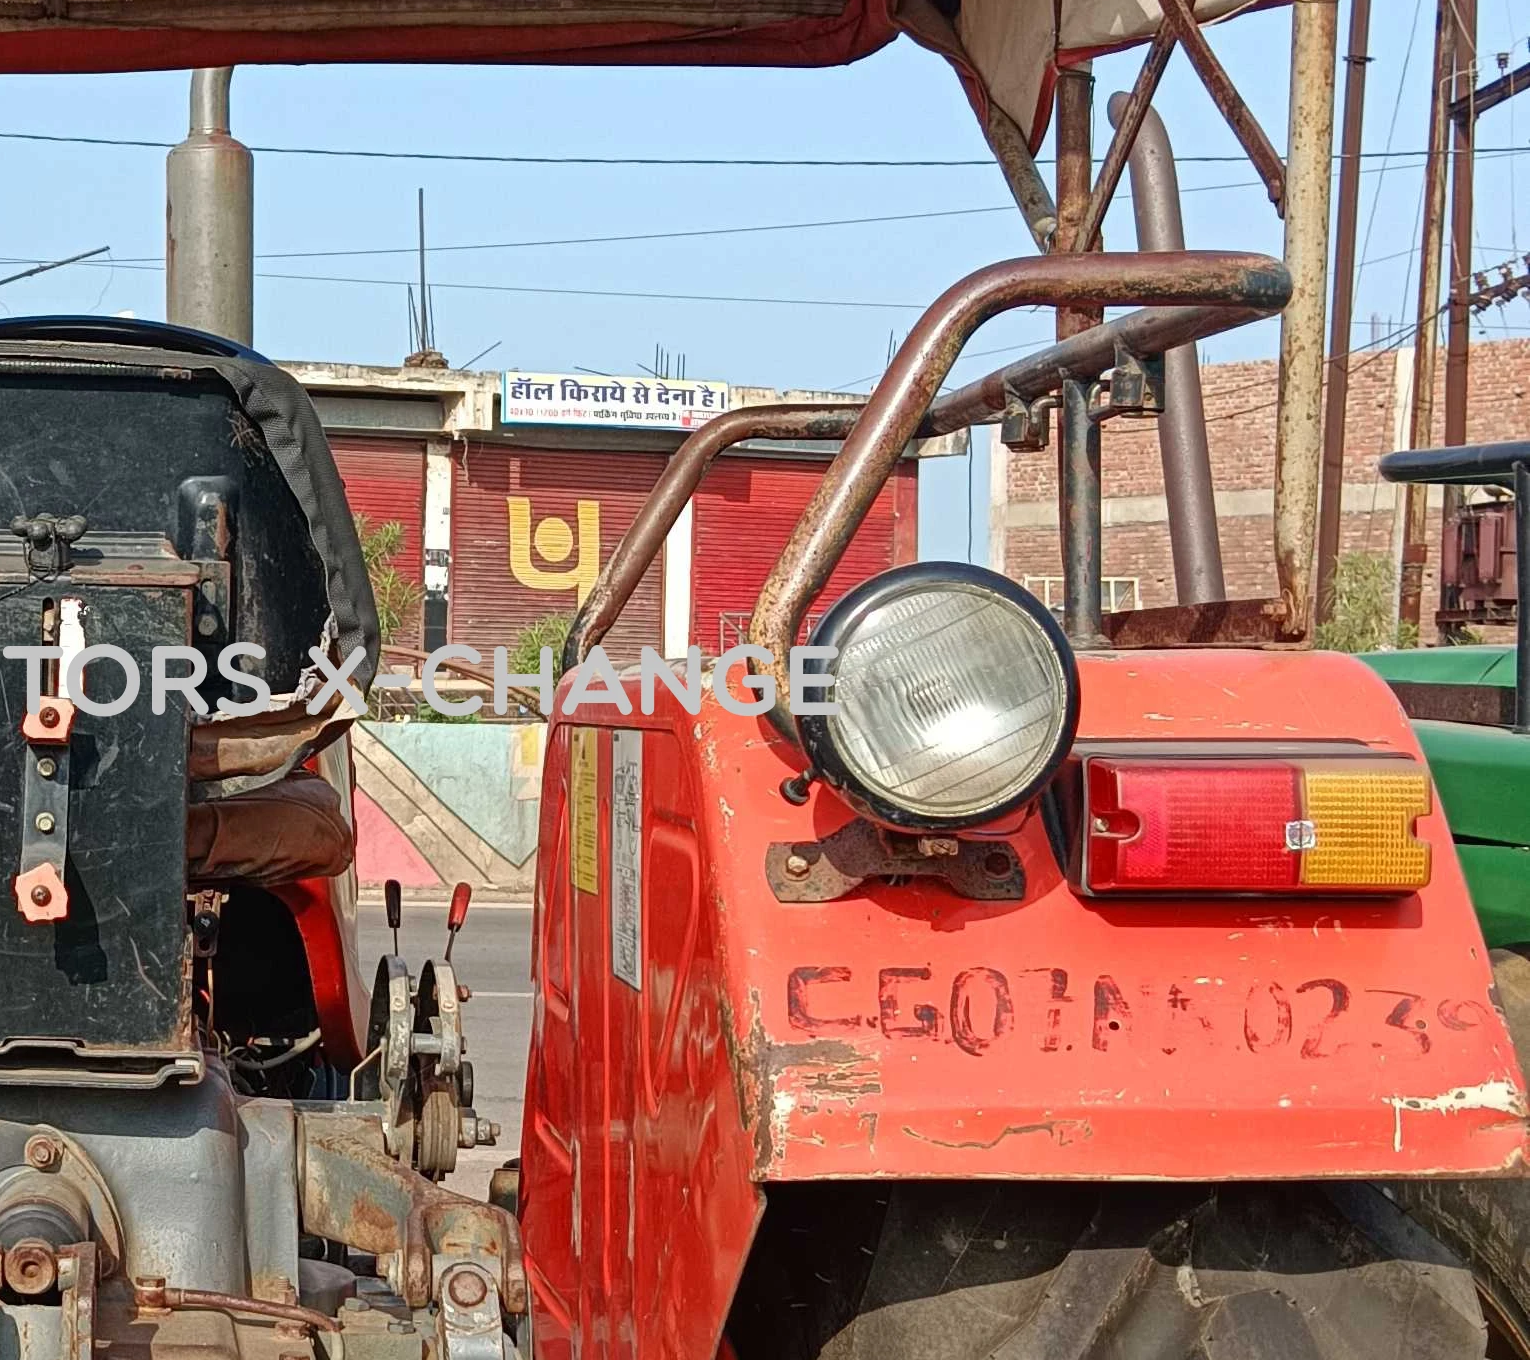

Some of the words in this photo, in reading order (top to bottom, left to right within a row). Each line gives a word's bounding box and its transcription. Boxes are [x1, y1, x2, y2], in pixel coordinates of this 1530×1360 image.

[510, 377, 554, 401] हॉल
[560, 378, 625, 403] किराये
[632, 381, 650, 404] से
[656, 383, 695, 406] देना
